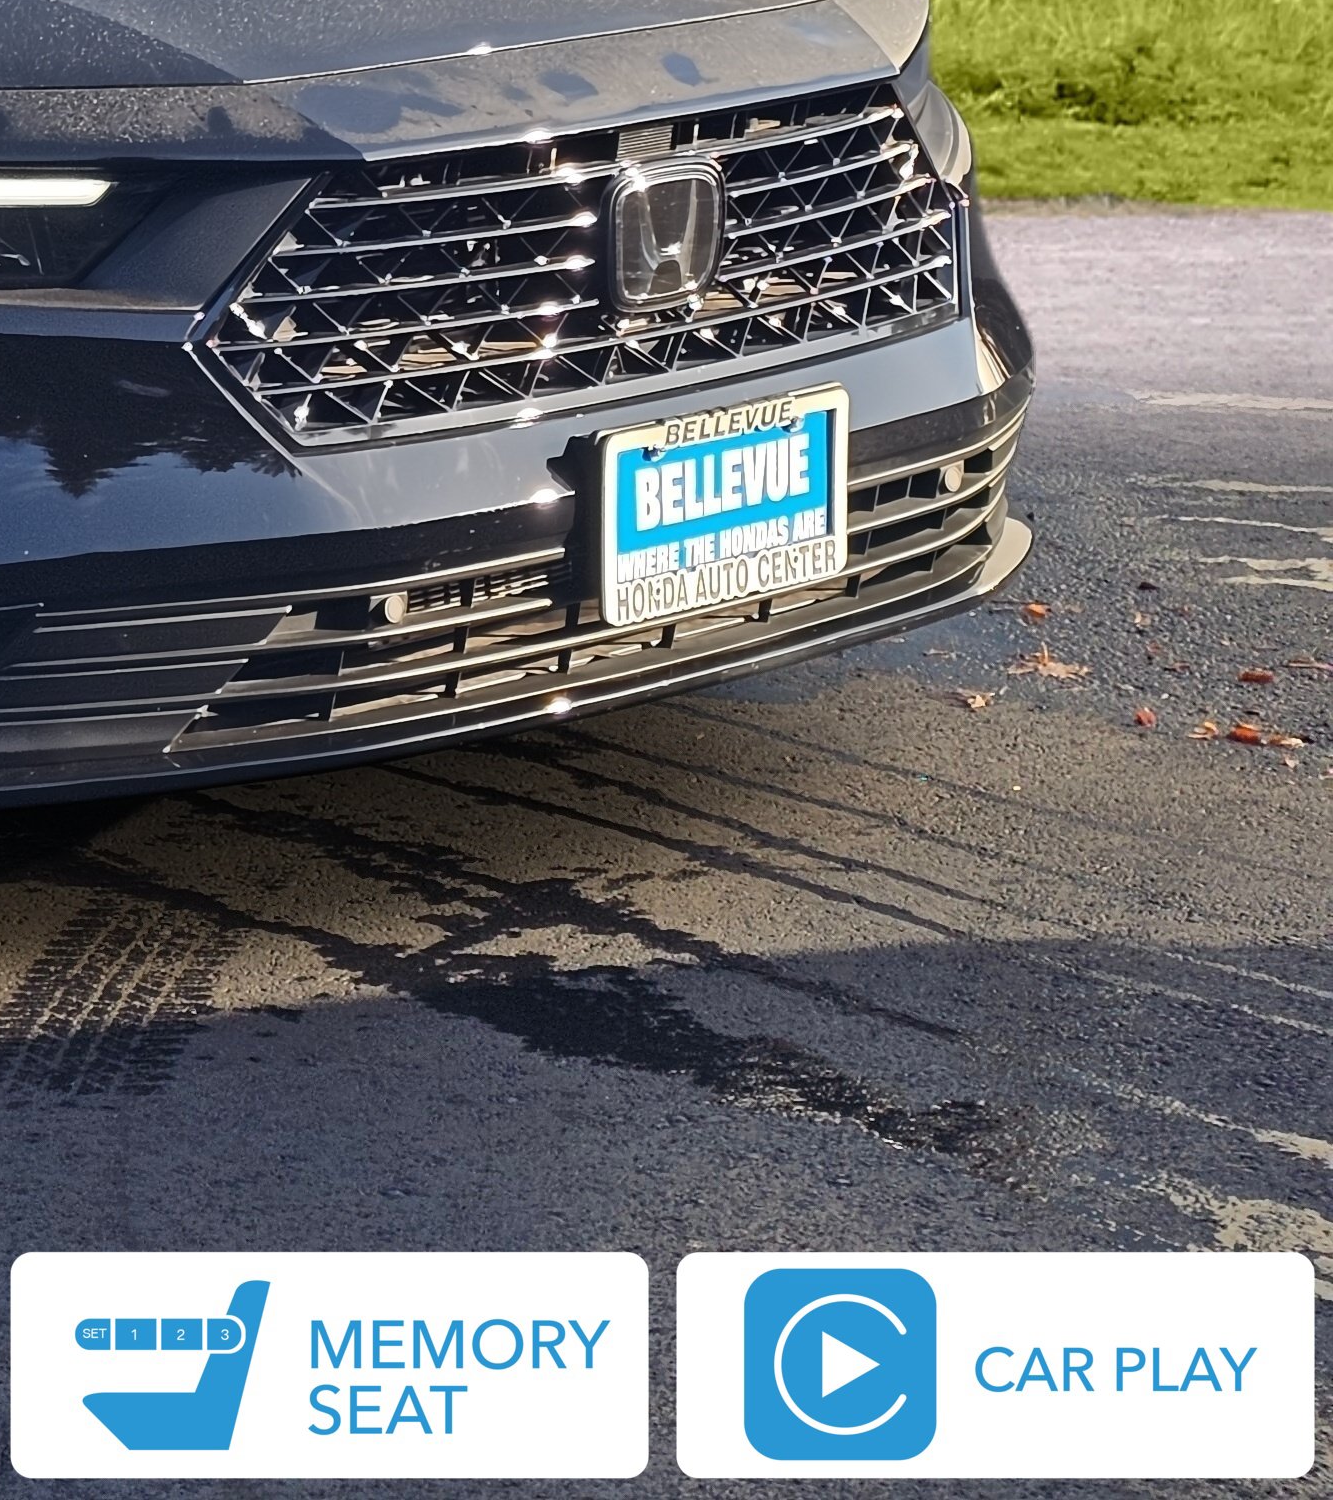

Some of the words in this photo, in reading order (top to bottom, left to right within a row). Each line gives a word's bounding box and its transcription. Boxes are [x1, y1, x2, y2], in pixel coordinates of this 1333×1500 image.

[664, 400, 794, 446] BELLEVUE
[634, 431, 811, 532] BELLEVUE
[616, 572, 690, 622] HONDA
[695, 557, 750, 604] AUTO
[757, 538, 837, 589] CENTER
[617, 541, 680, 584] WHERE
[683, 532, 716, 567] THE
[720, 515, 790, 561] HONDAS
[792, 506, 827, 542] ARE
